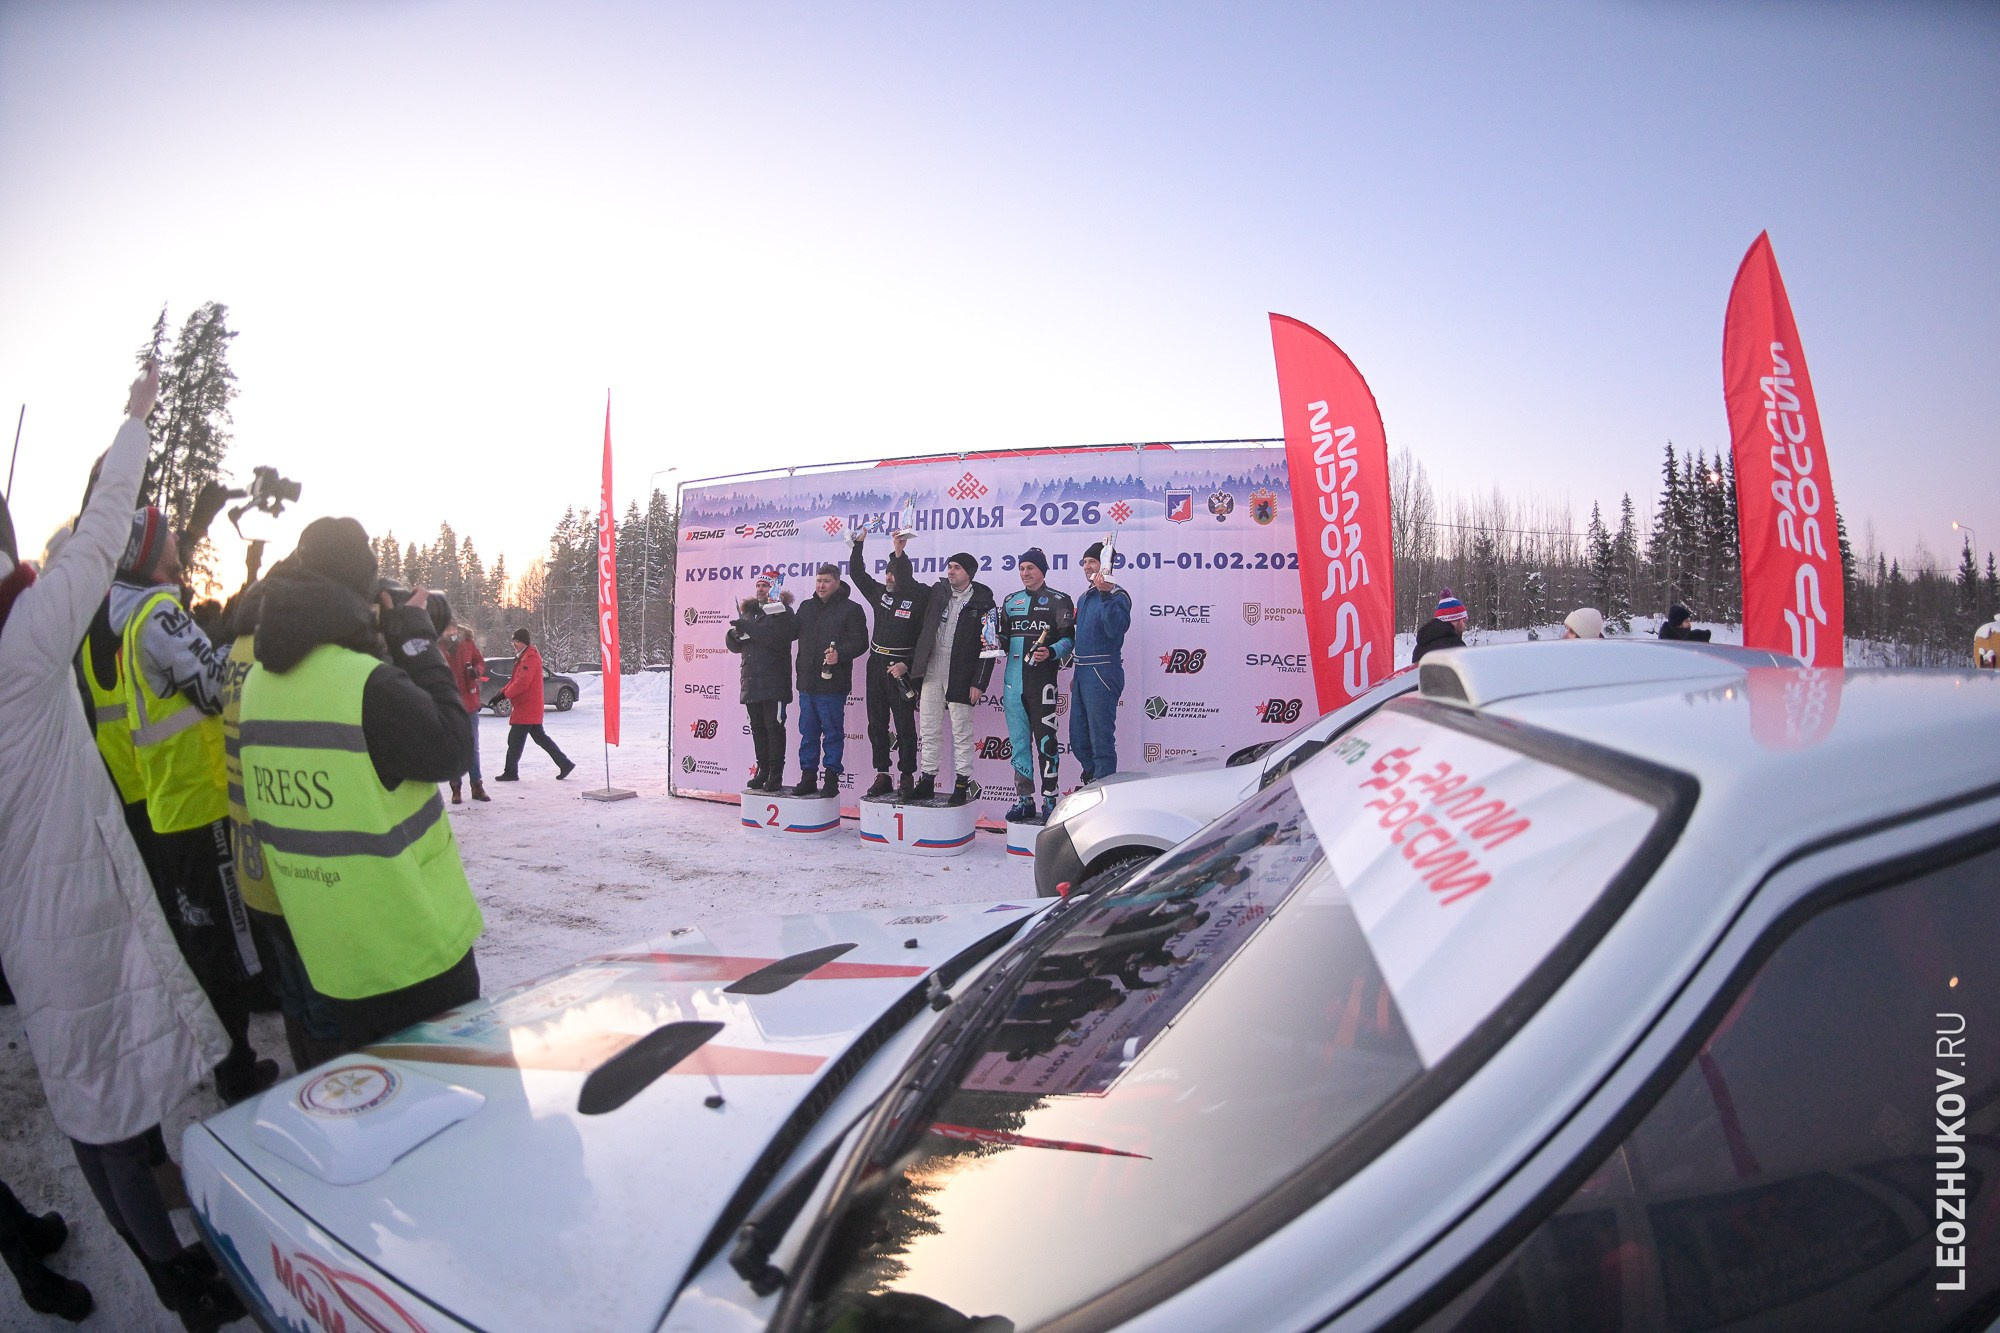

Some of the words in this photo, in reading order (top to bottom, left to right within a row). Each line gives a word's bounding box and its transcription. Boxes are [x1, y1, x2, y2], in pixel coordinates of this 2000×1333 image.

[756, 519, 795, 531] РАЛЛИ
[847, 505, 1004, 536] ЛАХДНПОХЬЯ
[1020, 500, 1101, 527] 2026
[690, 529, 726, 541] ASMG
[754, 527, 799, 540] РОССИИ
[685, 565, 744, 582] КУБОК
[980, 555, 992, 572] 2
[1149, 604, 1211, 618] SPACE
[1264, 607, 1306, 615] КОРПОРА
[1165, 648, 1207, 674] R8
[1245, 653, 1307, 667] SPACE
[684, 684, 721, 695] SPACE
[1261, 698, 1303, 724] R8
[693, 719, 718, 740] R8
[253, 765, 334, 811] PRESS
[766, 804, 780, 827] 2
[1408, 761, 1531, 851] РАЛЛИ
[893, 812, 904, 841] 1
[1363, 786, 1492, 907] РОССИИ
